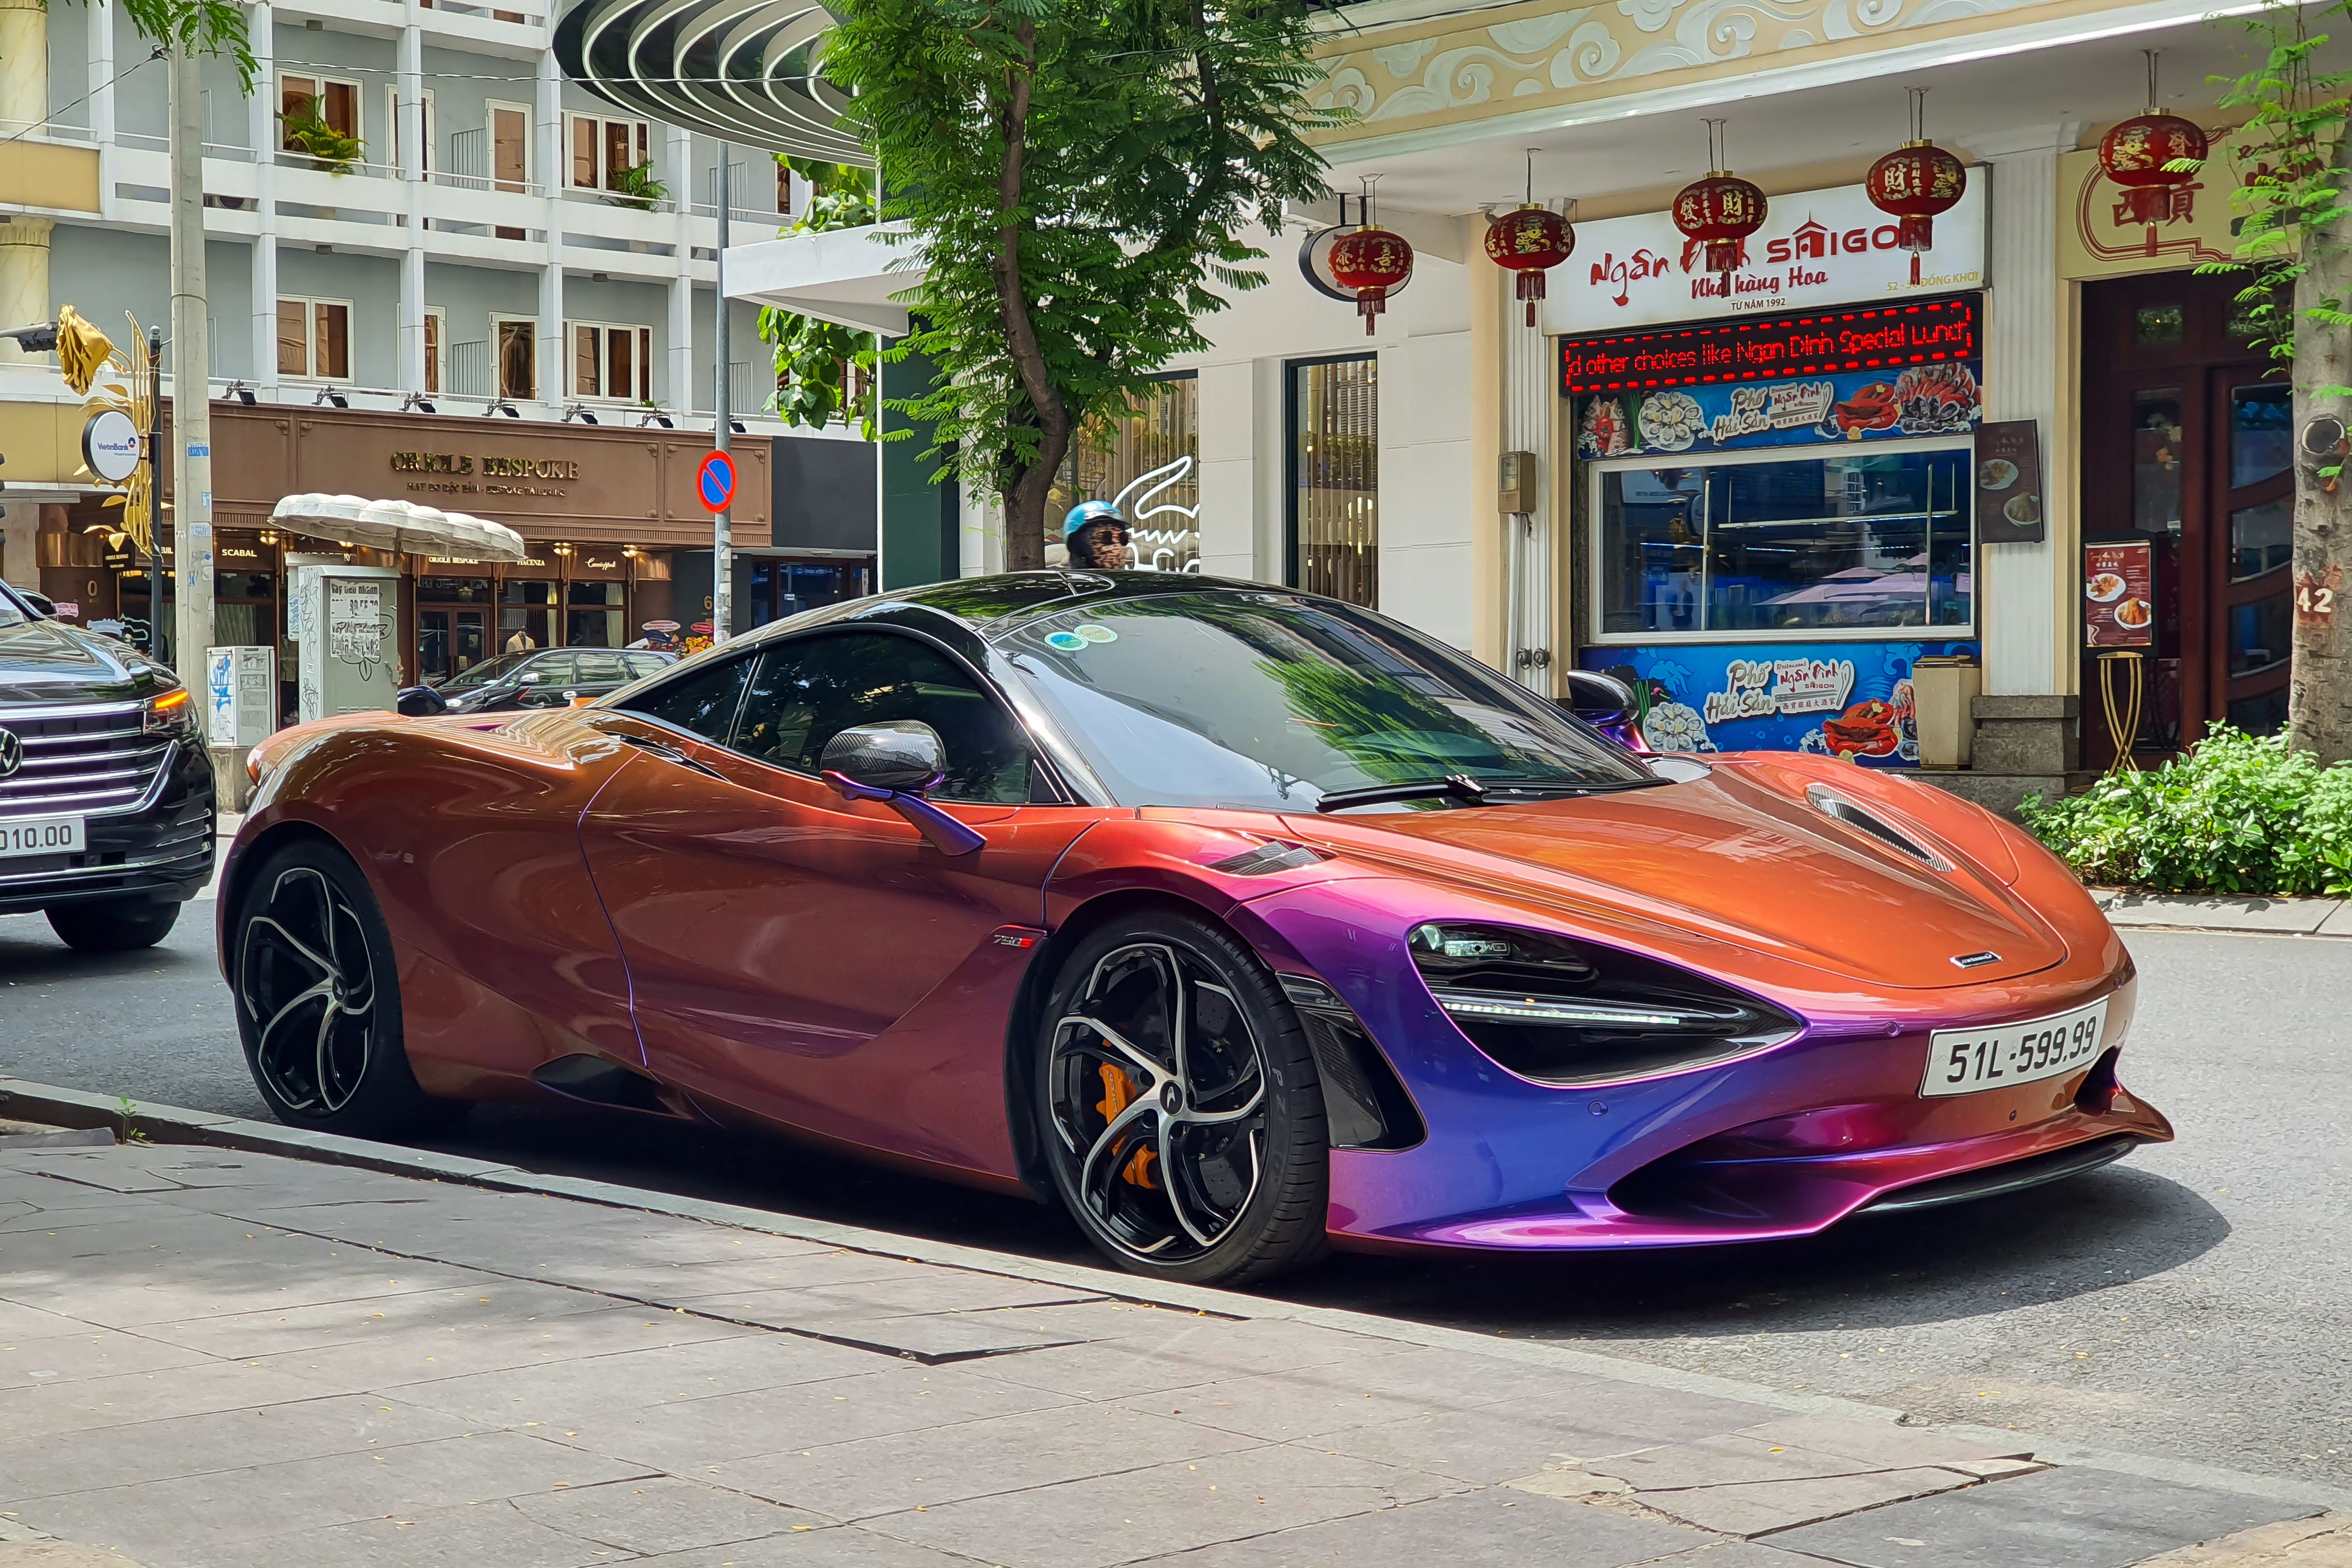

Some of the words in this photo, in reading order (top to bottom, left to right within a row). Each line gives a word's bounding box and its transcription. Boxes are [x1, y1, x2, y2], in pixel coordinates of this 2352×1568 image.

[1884, 164, 1908, 192] 財
[1722, 190, 1743, 216] 財
[1374, 243, 1395, 267] 喜
[1590, 249, 1670, 306] Ngân
[1766, 211, 1900, 264] SAIGO
[1735, 274, 1780, 295] hàng
[1788, 265, 1829, 289] Hoa
[1886, 281, 1899, 291] 52
[1744, 298, 1764, 310] NĂM
[1766, 298, 1786, 307] 1992
[1586, 353, 1629, 375] other
[1634, 349, 1696, 370] choices
[1703, 343, 1731, 365] like
[1737, 340, 1784, 364] Ngan
[1790, 331, 1834, 358] Dinh
[1840, 323, 1905, 355] Special
[1732, 389, 1766, 416] Phố
[97, 442, 129, 451] VietinBank
[390, 452, 474, 475] ORIOLE
[482, 456, 581, 481] BESPOKE
[486, 485, 522, 495] BESPOKE
[524, 486, 566, 496] TAILORING
[222, 548, 257, 558] SCABAL
[2297, 587, 2333, 612] 42
[1730, 663, 1770, 695] Phố
[1780, 669, 1810, 692] Ngân
[1706, 694, 1737, 720] Hải
[1741, 692, 1773, 713] Sản
[1947, 1016, 2097, 1084] 51L-599.99
